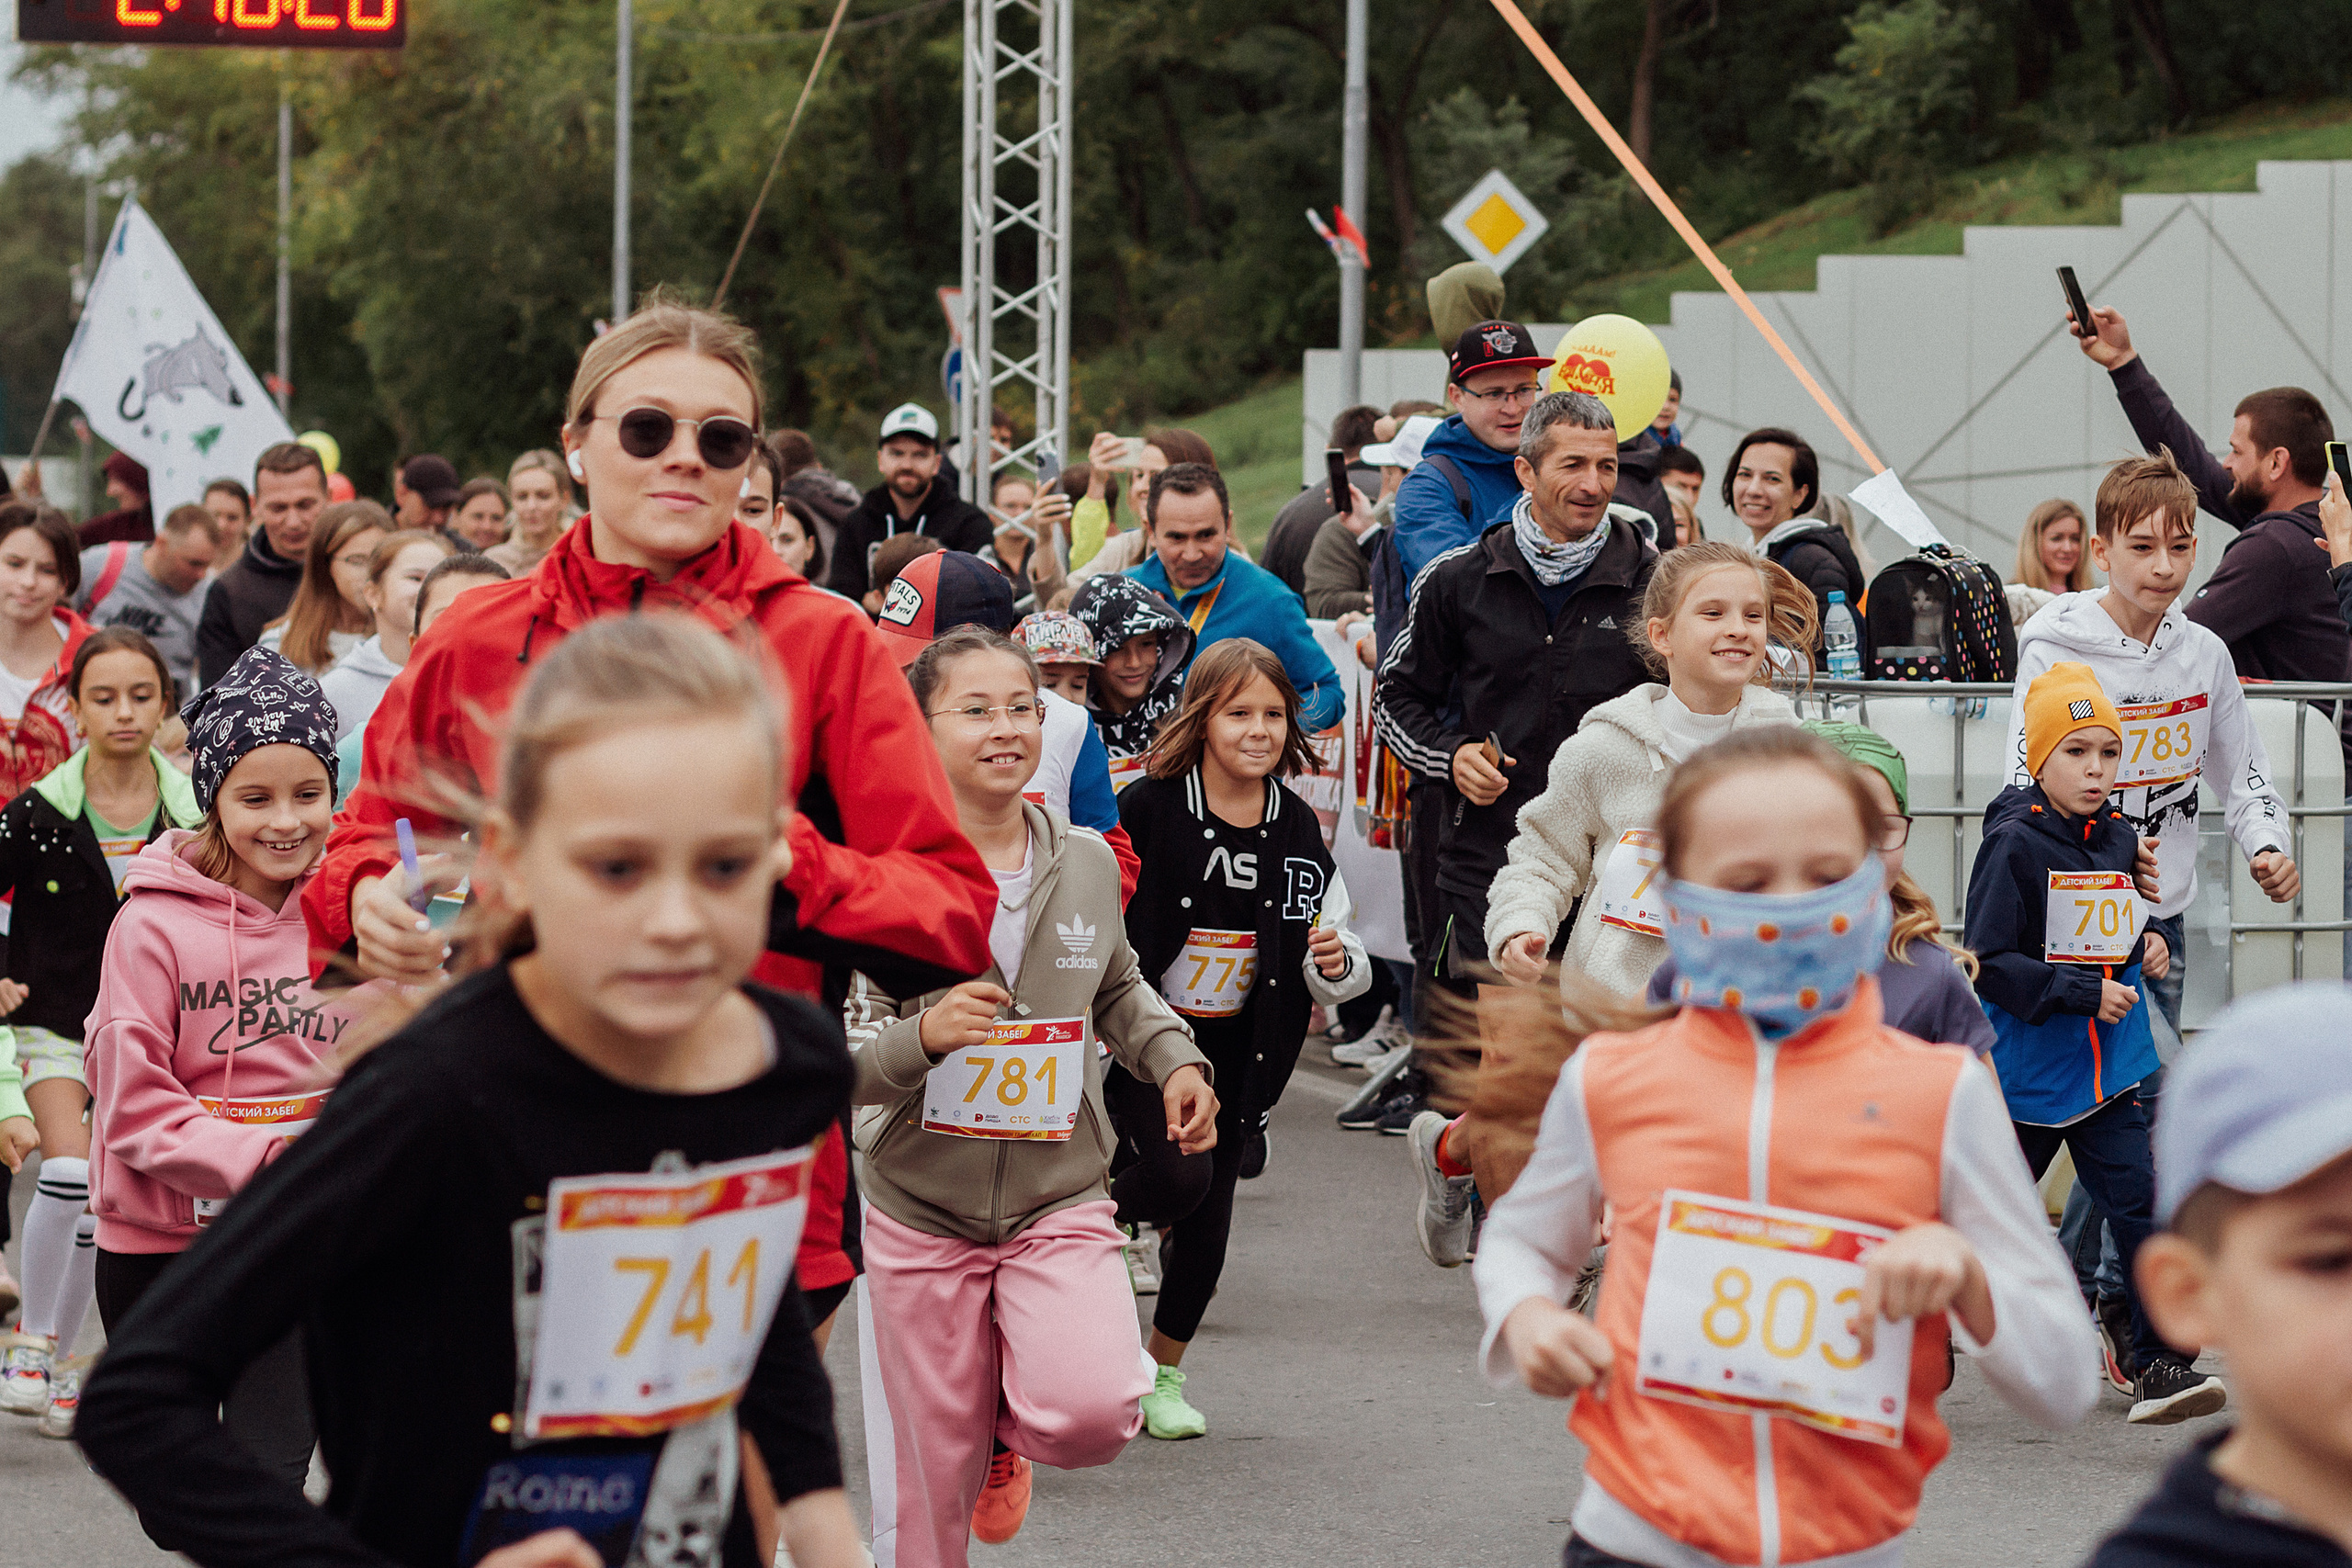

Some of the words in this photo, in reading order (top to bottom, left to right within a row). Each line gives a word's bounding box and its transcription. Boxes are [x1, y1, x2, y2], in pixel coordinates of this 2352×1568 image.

[1025, 619, 1088, 648] MARVEL
[2149, 706, 2167, 715] ЗАБЕГ
[2129, 721, 2192, 764] 783
[1283, 857, 1325, 920] R
[2060, 877, 2094, 886] ДЕТСКИЙ
[2095, 877, 2112, 886] ЗАБЕГ
[2075, 898, 2134, 937] 701
[1188, 933, 1211, 942] СКИЙ
[1212, 935, 1234, 944] ЗАБЕГ
[1056, 954, 1099, 970] adidas
[1186, 953, 1257, 993] 775
[180, 976, 300, 1011] MAGIC
[997, 1029, 1024, 1040] ЗАБЕГ
[962, 1056, 1057, 1107] 781
[210, 1105, 263, 1118] ДТСКИЙ
[264, 1105, 296, 1117] ЗАБЕГ
[1010, 1115, 1031, 1124] СТС
[611, 1235, 762, 1359] 741
[1701, 1266, 1864, 1371] 803
